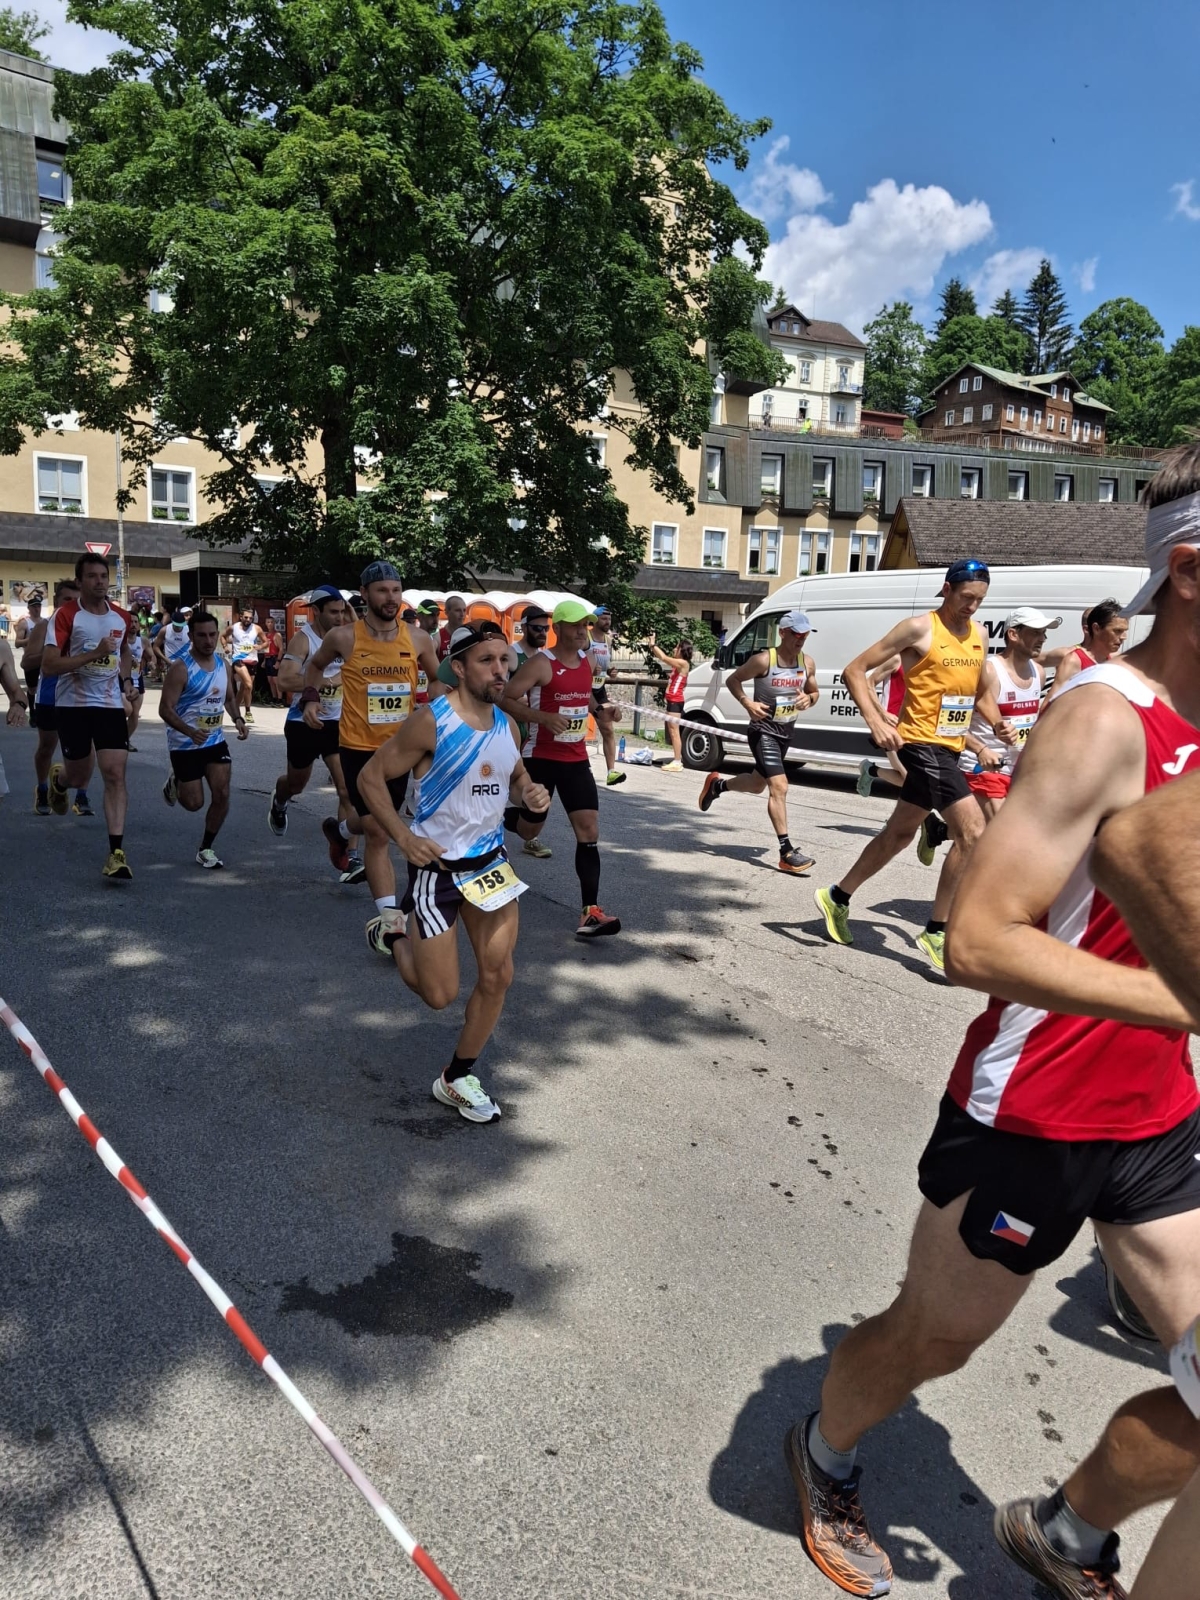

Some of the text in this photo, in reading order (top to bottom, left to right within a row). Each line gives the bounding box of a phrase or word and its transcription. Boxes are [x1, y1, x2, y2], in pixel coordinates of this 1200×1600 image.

[942, 658, 982, 667] GERMAN
[771, 678, 804, 688] GERMANY
[378, 697, 402, 710] 102
[1012, 701, 1037, 709] POLSKA
[947, 710, 967, 723] 505
[1019, 728, 1031, 740] 99
[471, 783, 500, 796] ARG
[472, 869, 506, 895] 758
[446, 1085, 475, 1111] TERREX
